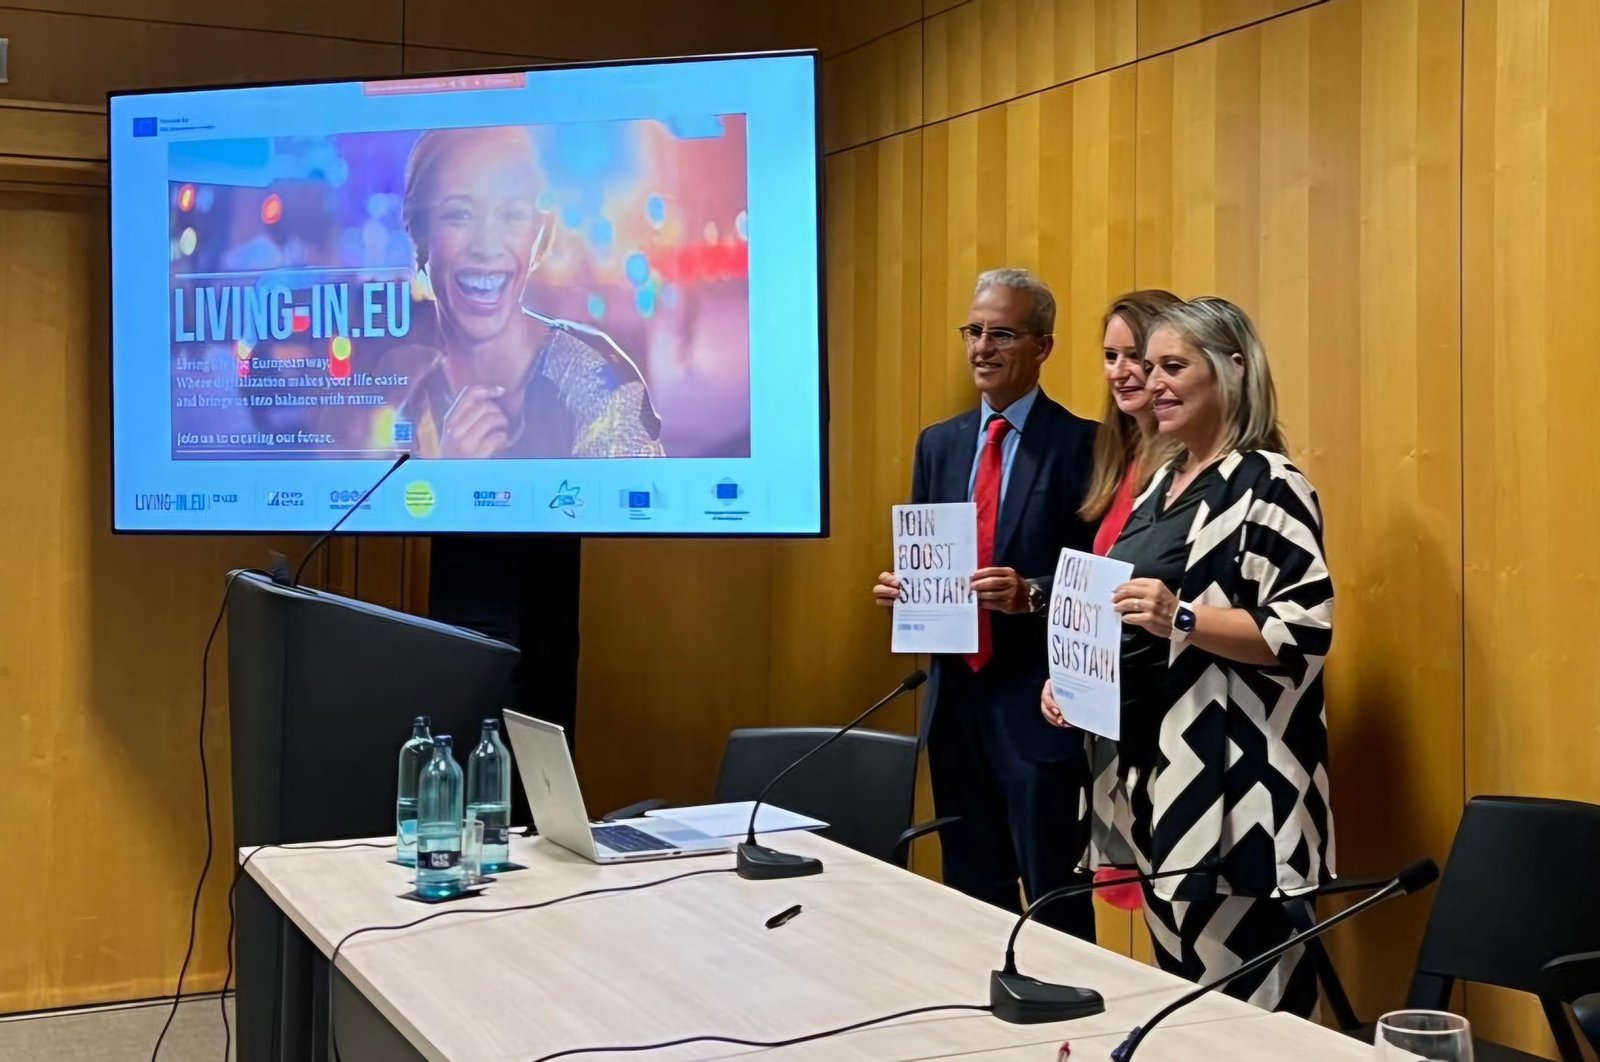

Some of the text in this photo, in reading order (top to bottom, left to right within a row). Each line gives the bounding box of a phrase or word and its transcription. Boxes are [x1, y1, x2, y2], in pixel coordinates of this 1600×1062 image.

[174, 281, 411, 342] LIVING-IN.EU
[251, 357, 305, 372] European
[353, 372, 372, 386] life
[374, 373, 408, 386] easier
[176, 394, 197, 407] and
[275, 392, 317, 406] balance
[320, 392, 345, 405] with
[275, 433, 295, 444] our
[898, 509, 935, 537] JOIN
[898, 543, 955, 571] BOOST
[1057, 553, 1093, 593] JOIN
[1051, 594, 1101, 638] BOOST
[1051, 634, 1115, 684] SUSTAIN
